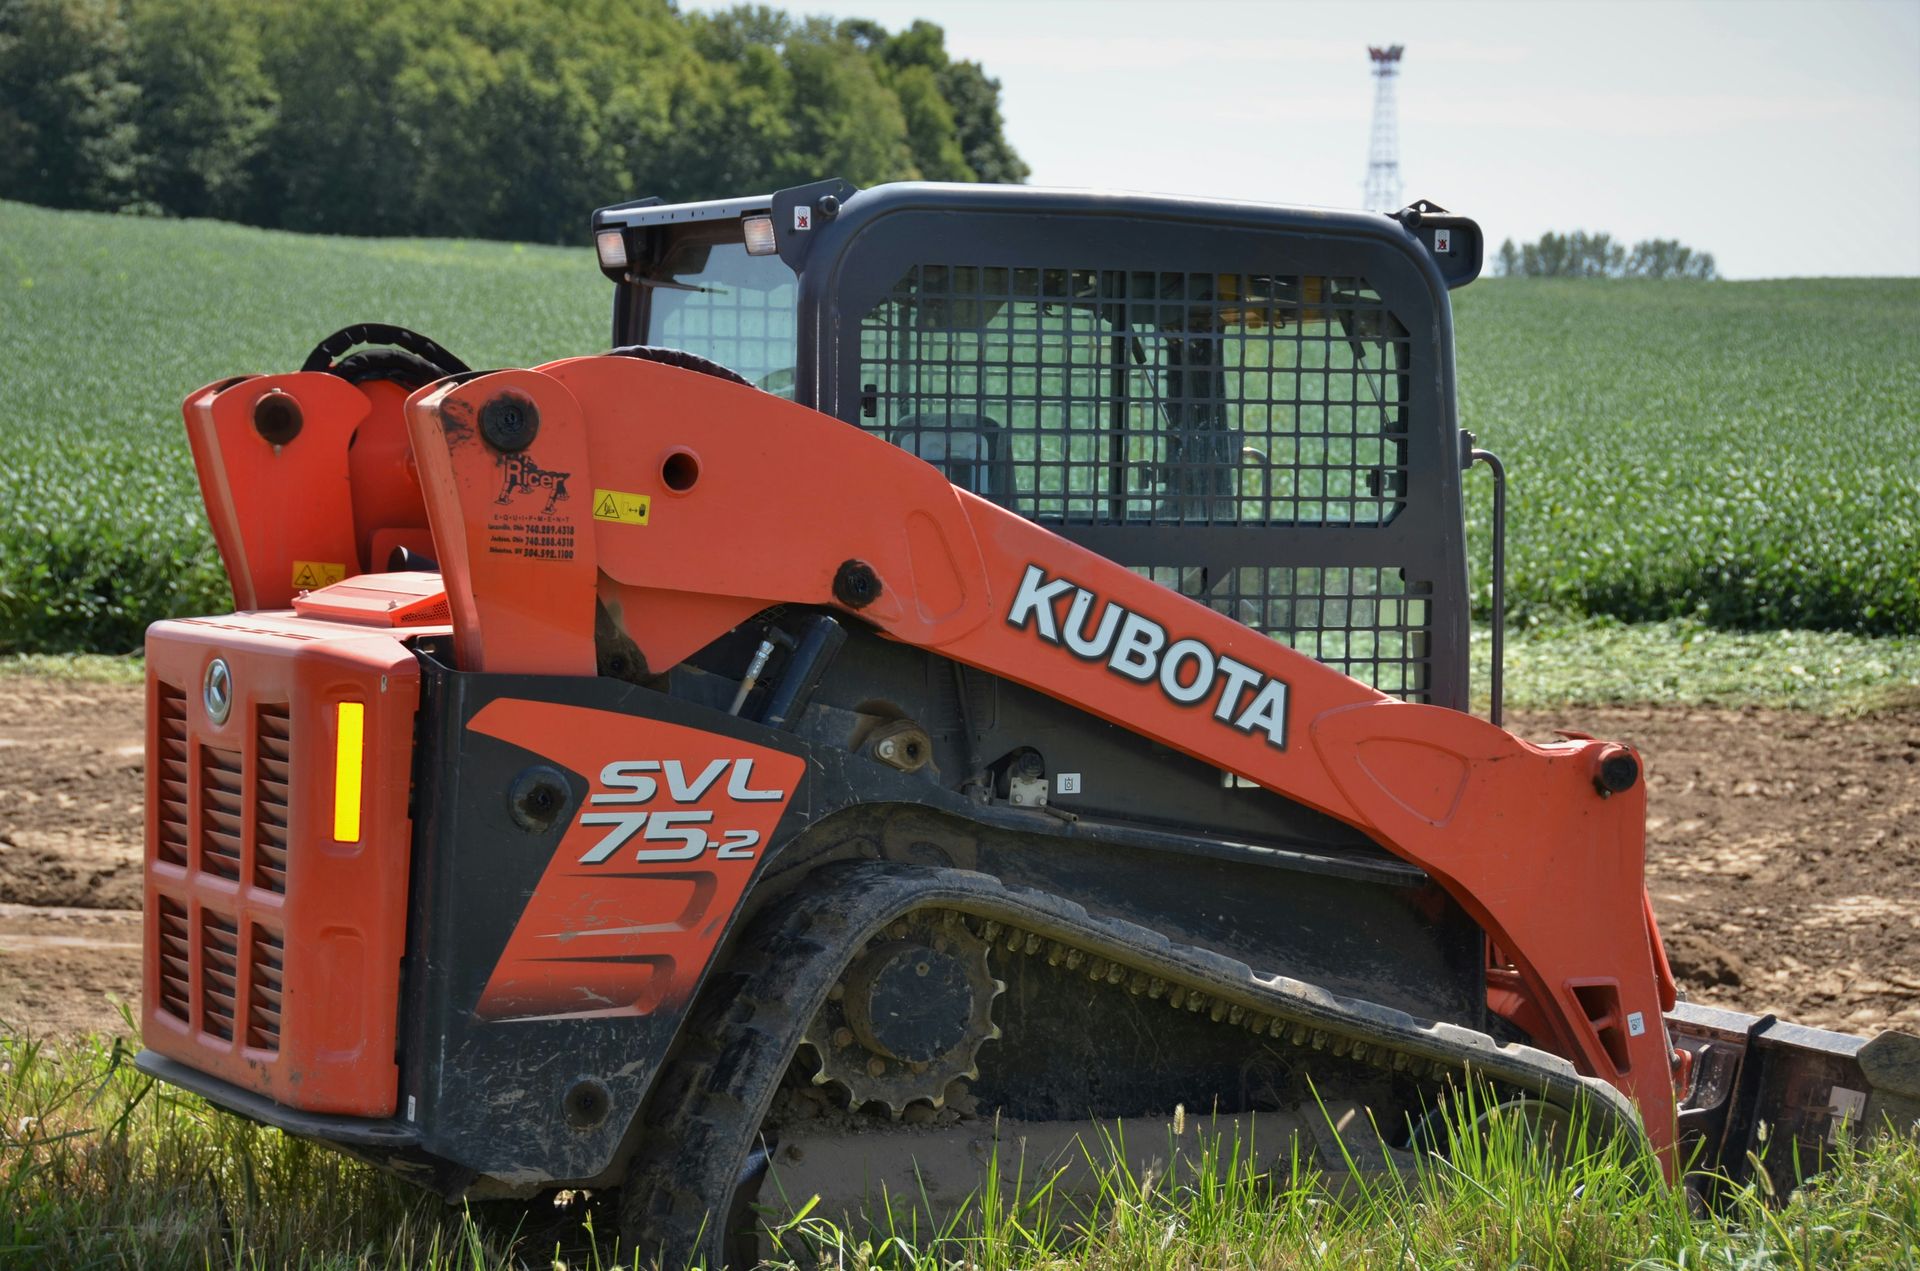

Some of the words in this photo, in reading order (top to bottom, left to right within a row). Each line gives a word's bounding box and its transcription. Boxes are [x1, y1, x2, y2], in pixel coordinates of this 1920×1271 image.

[1007, 564, 1289, 747] KUBOTA
[590, 758, 784, 805] SVL
[577, 810, 761, 865] 75-2
